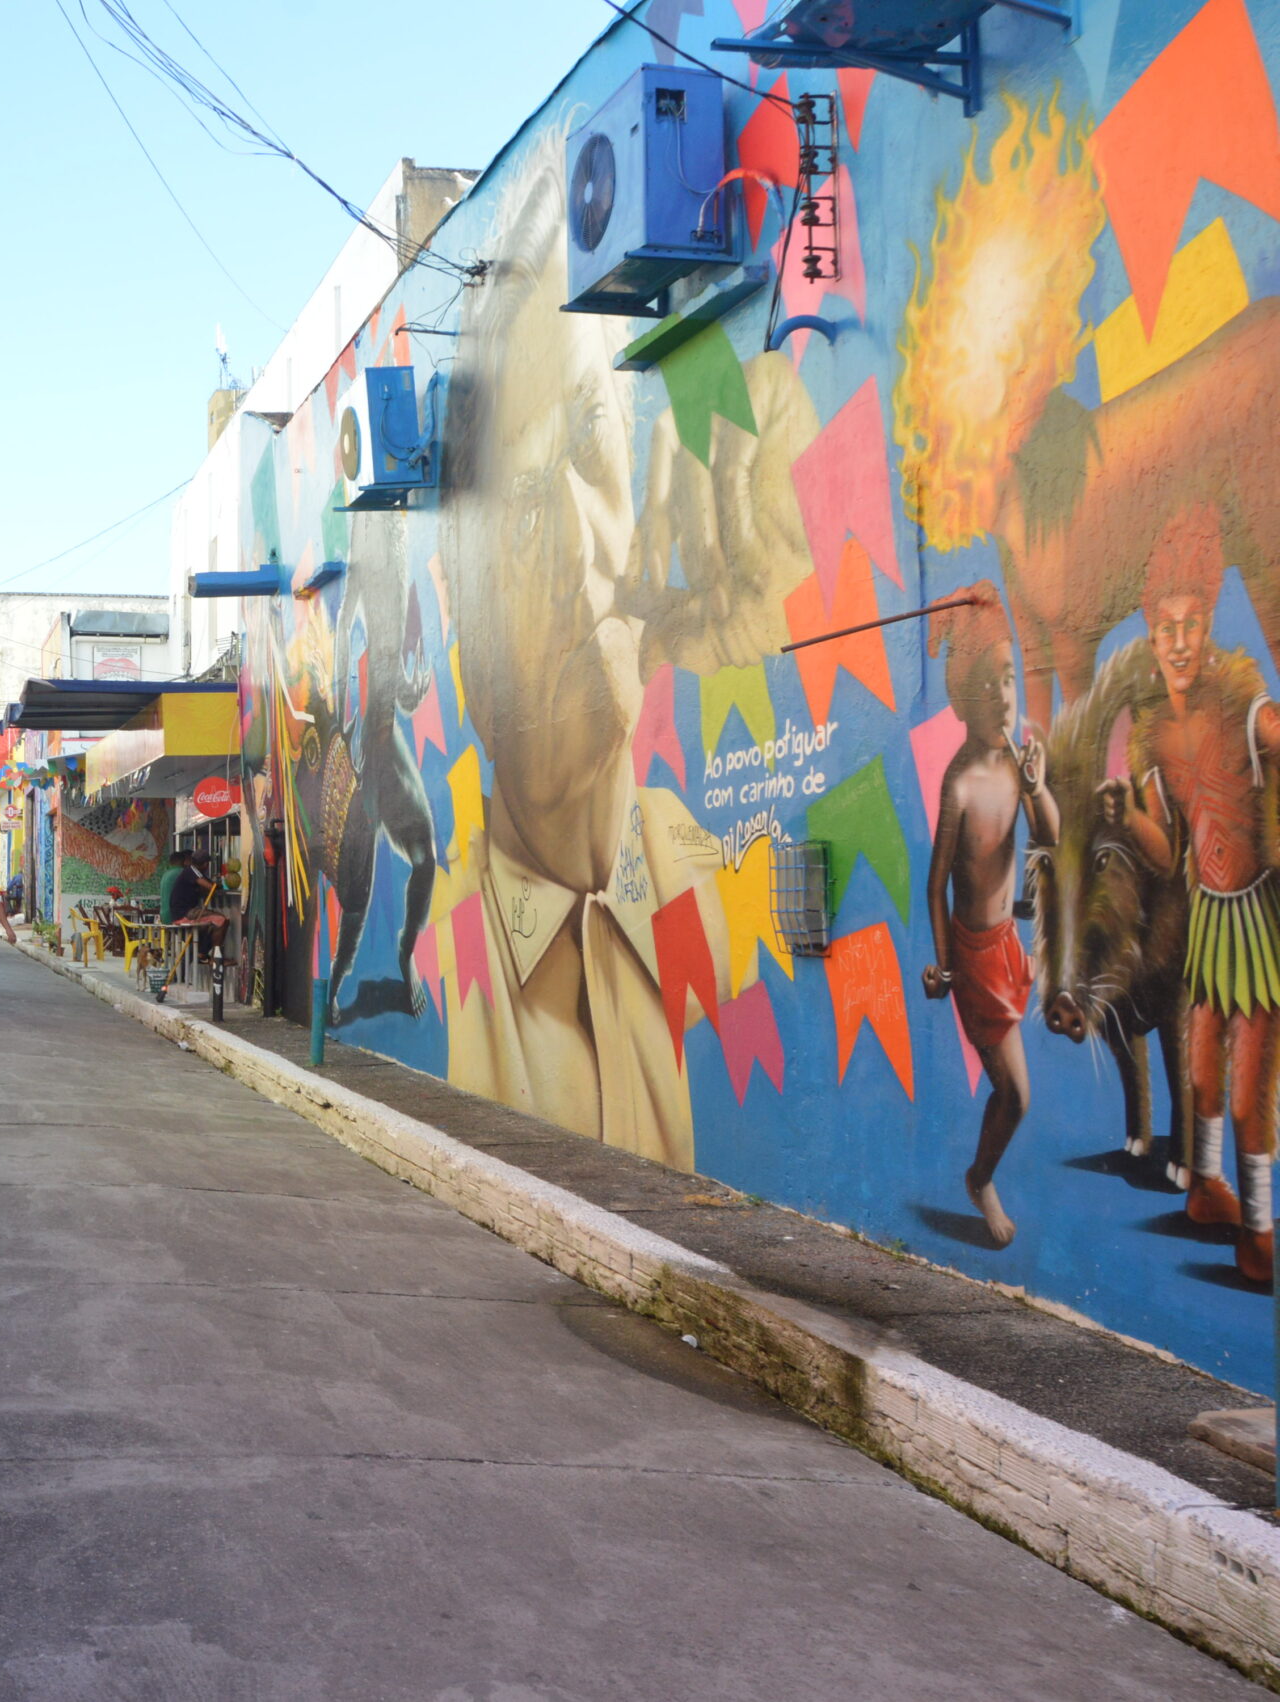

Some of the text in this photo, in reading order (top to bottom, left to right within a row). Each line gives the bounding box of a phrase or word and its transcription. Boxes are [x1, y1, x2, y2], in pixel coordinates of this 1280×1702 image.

[703, 719, 839, 784] Ao povo potiguar
[704, 786, 733, 809] com
[740, 771, 794, 804] carinho
[802, 765, 827, 795] de
